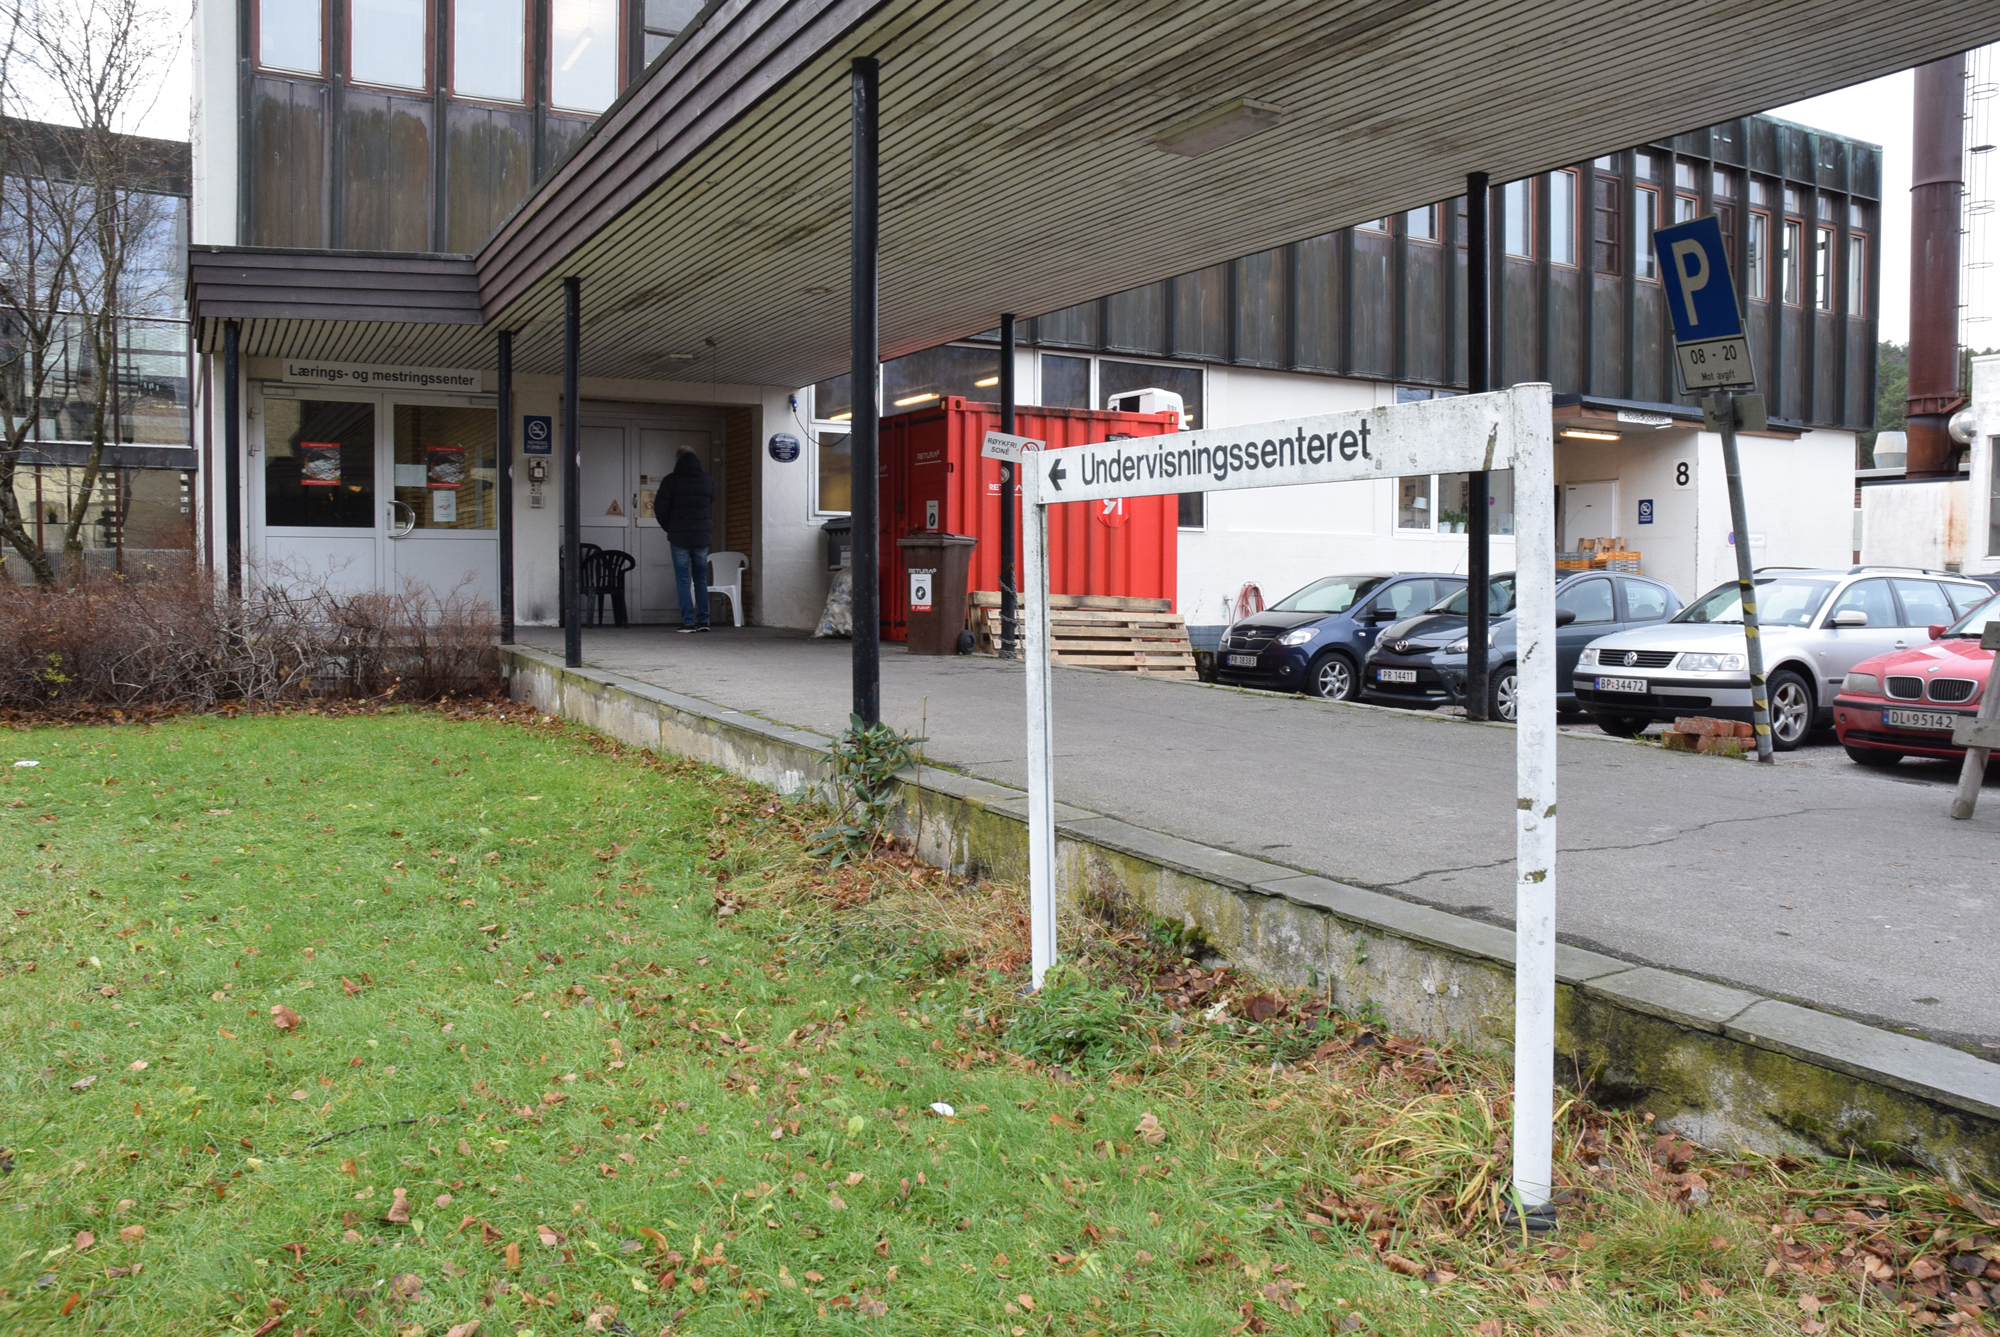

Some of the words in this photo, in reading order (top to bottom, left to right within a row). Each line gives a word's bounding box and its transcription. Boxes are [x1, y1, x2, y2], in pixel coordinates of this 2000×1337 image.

[1670, 238, 1711, 326] P
[1690, 348, 1706, 365] 08
[1722, 344, 1737, 361] 20
[289, 364, 349, 381] Lærings-
[352, 370, 369, 382] og
[372, 370, 475, 386] mestringssenter
[1717, 369, 1736, 382] avgift
[987, 437, 1017, 449] RØYKFRI
[1081, 418, 1371, 486] Undervisningssenteret
[1676, 461, 1690, 486] 8
[1383, 670, 1391, 680] PR
[1601, 678, 1611, 689] BP
[1615, 679, 1644, 691] 34472
[1892, 711, 1906, 725] DL
[1912, 713, 1953, 728] 95142
